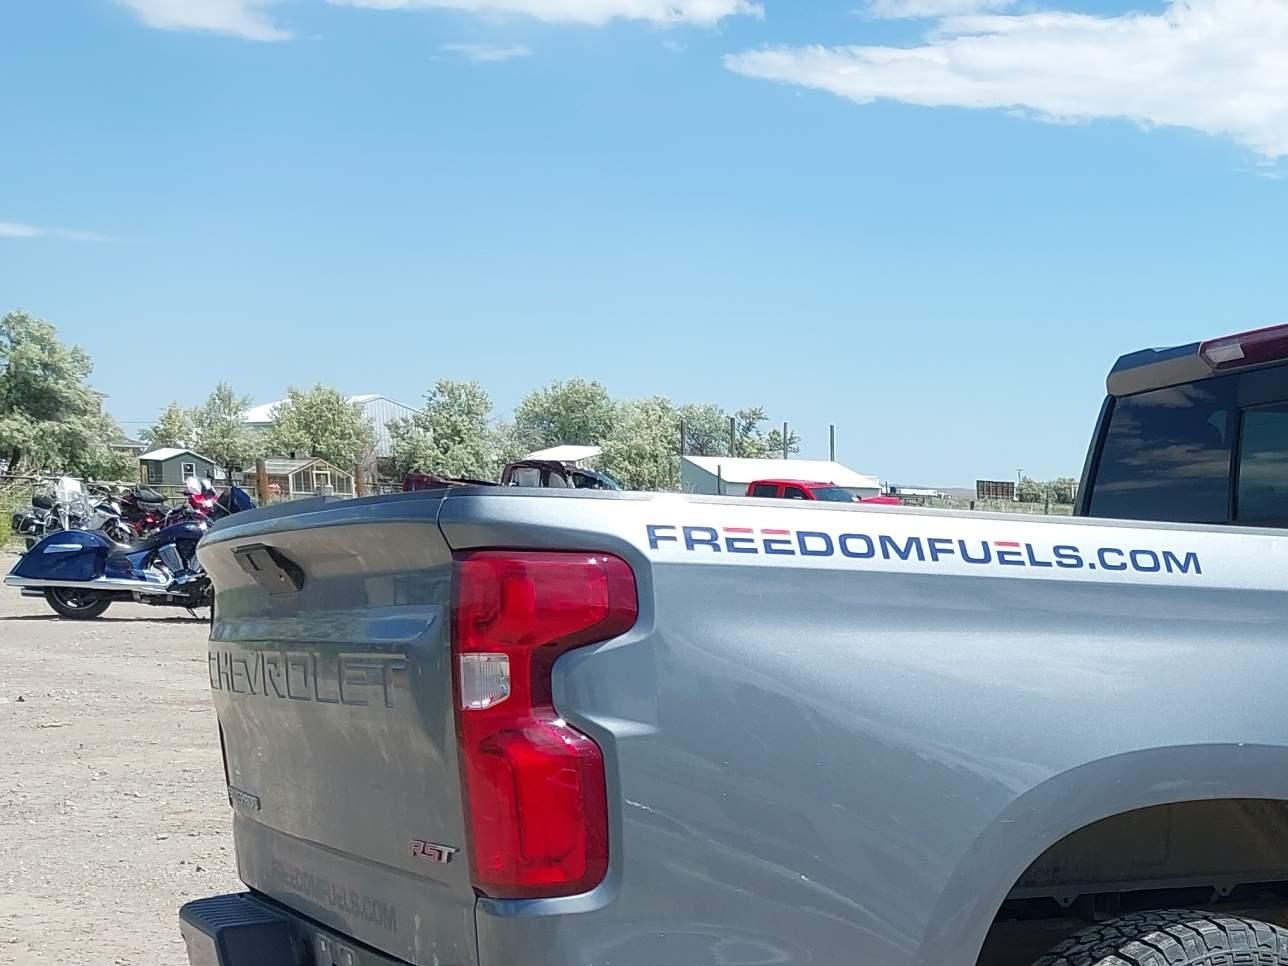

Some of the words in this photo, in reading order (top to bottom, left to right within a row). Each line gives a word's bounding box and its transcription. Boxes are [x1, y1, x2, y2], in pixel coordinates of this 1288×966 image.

[645, 524, 1203, 575] FREEDOMFUELS.COM
[208, 650, 407, 708] CHEVROLET
[410, 839, 459, 864] RST
